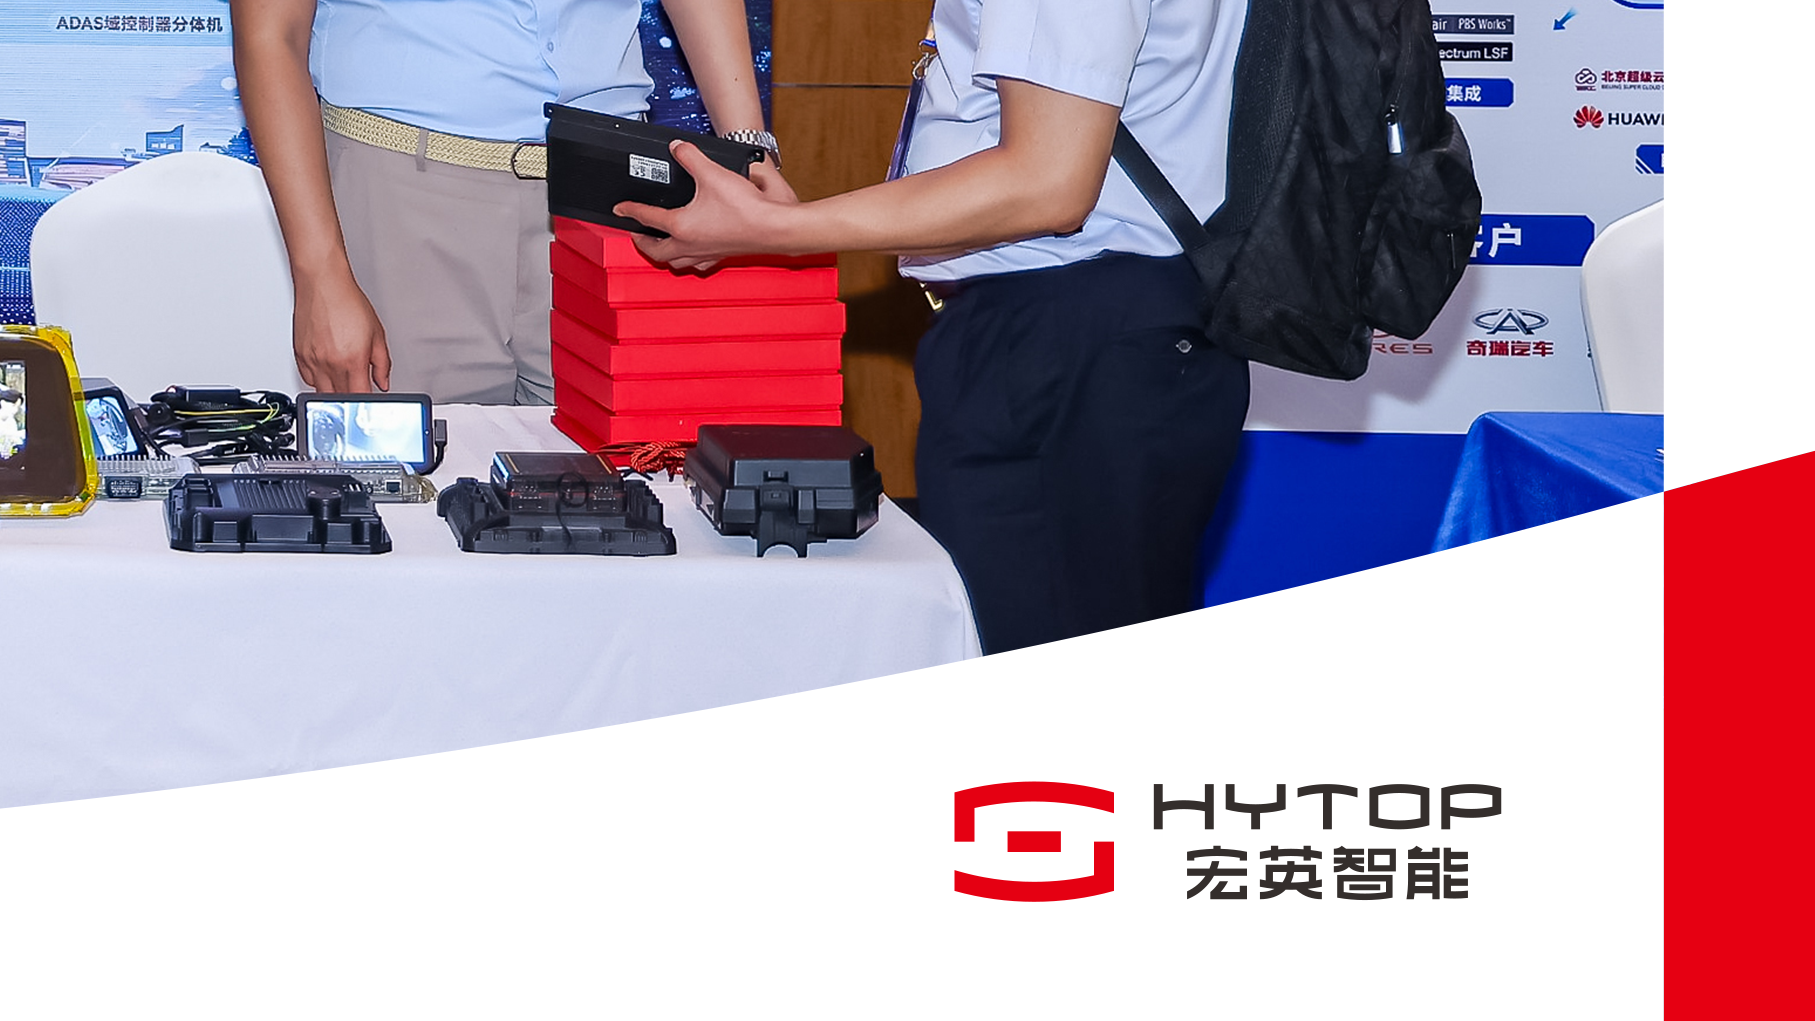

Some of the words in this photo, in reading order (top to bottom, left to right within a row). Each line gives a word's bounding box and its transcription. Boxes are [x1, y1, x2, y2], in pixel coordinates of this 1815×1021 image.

[56, 15, 223, 33] ADAS域控制器分体机
[1484, 47, 1508, 59] LSF
[1446, 84, 1482, 102] 集成
[1608, 113, 1664, 126] HUAW
[1467, 340, 1554, 357] 奇瑞汽车
